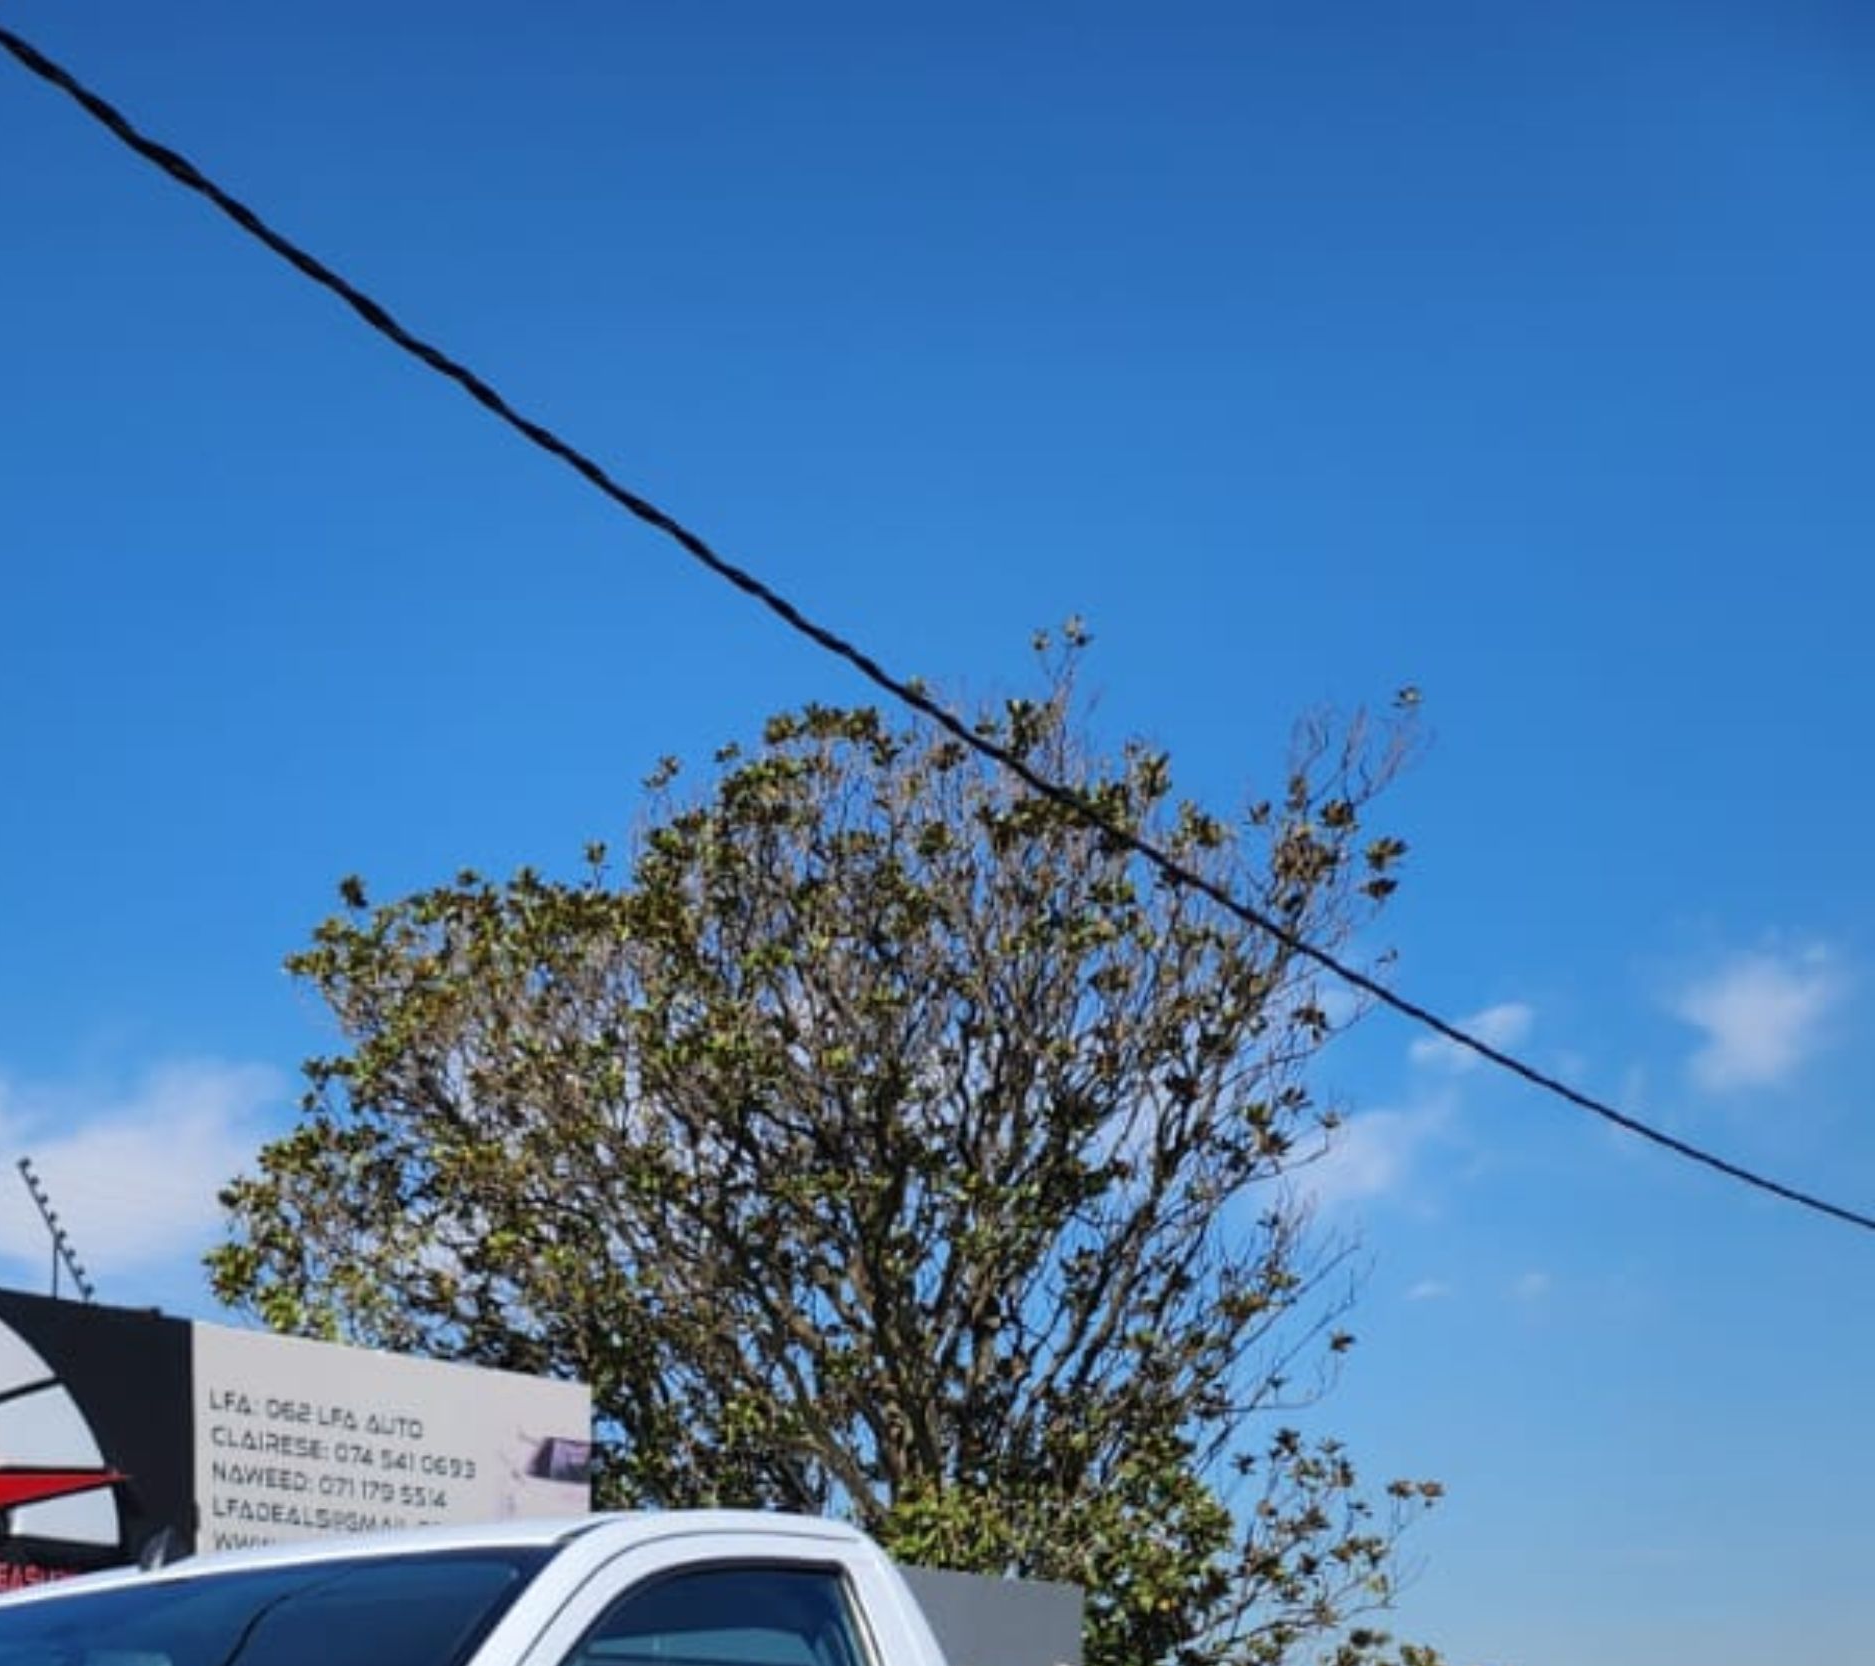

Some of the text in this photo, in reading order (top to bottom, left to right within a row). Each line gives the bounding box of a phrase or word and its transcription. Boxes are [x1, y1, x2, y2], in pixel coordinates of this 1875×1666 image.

[265, 1399, 312, 1424] 062
[317, 1405, 358, 1432] LFA
[365, 1414, 424, 1441] AUTO
[333, 1442, 374, 1467] 074
[318, 1475, 354, 1499] 071
